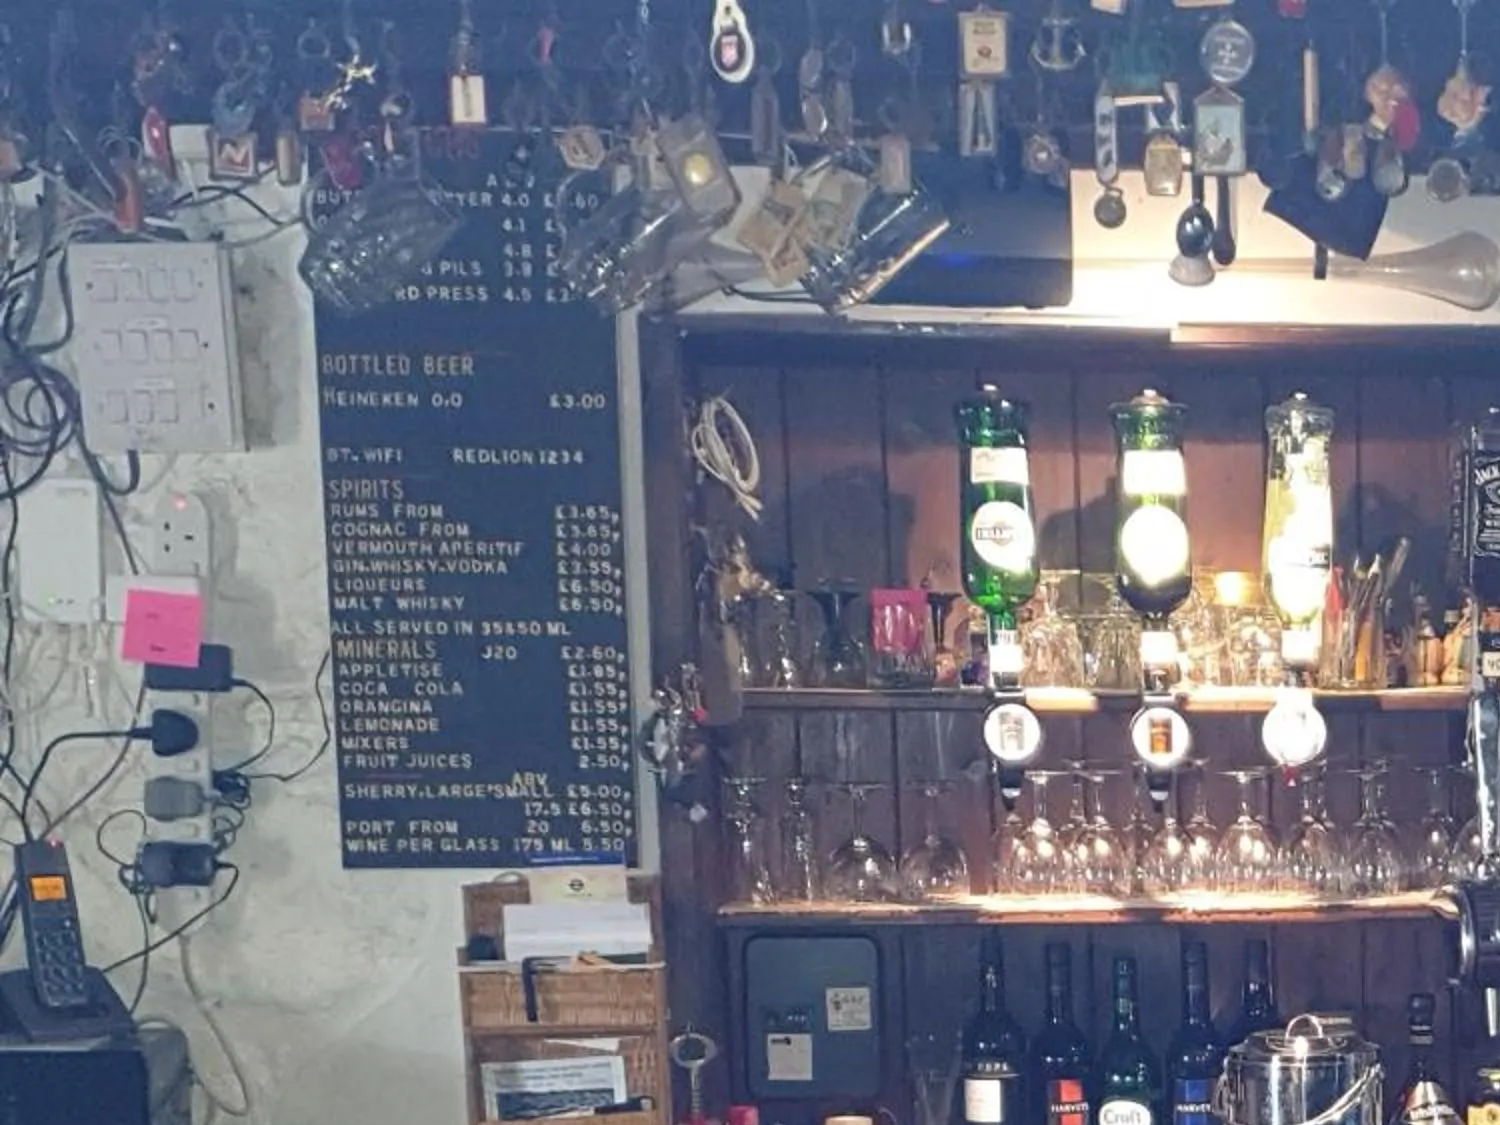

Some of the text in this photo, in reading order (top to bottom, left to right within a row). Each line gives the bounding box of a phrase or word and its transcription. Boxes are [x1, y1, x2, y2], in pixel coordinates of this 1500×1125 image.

[440, 262, 482, 276] PILS
[427, 287, 489, 301] PRESS
[322, 355, 474, 376] BOTTLED BEER
[323, 387, 419, 408] HEINEKEN
[549, 394, 606, 409] £3.00
[328, 480, 404, 500] SPIRITS
[331, 504, 379, 519] RUMS
[394, 504, 444, 519] FROM
[332, 523, 406, 537] COGNAC
[420, 523, 470, 537] FROM
[332, 541, 434, 556] VERMOUTH
[439, 541, 525, 557] APERITIF
[333, 578, 427, 592] LIQUEURS
[334, 597, 382, 611] MALT
[396, 597, 465, 611] WHISKY
[331, 621, 366, 635] ALL
[374, 621, 448, 636] SERVED
[455, 621, 473, 635] IN
[546, 622, 571, 636] ML
[337, 640, 437, 660] MINERALS
[338, 663, 444, 678] APPLETISE
[339, 682, 389, 696] COCA
[414, 681, 465, 696] COLA
[340, 700, 433, 714] ORANGINA
[341, 718, 441, 733] LEMONADE
[341, 736, 410, 750] MIXERS
[343, 754, 400, 769] FRUIT
[406, 753, 473, 769] JUICES
[511, 771, 549, 787] ABV
[524, 802, 561, 817] 17.5
[346, 820, 396, 834] PORT
[408, 820, 459, 834] FROM
[527, 820, 550, 834] 20
[346, 837, 625, 853] WINE PER GLASS 175 ML 5.50
